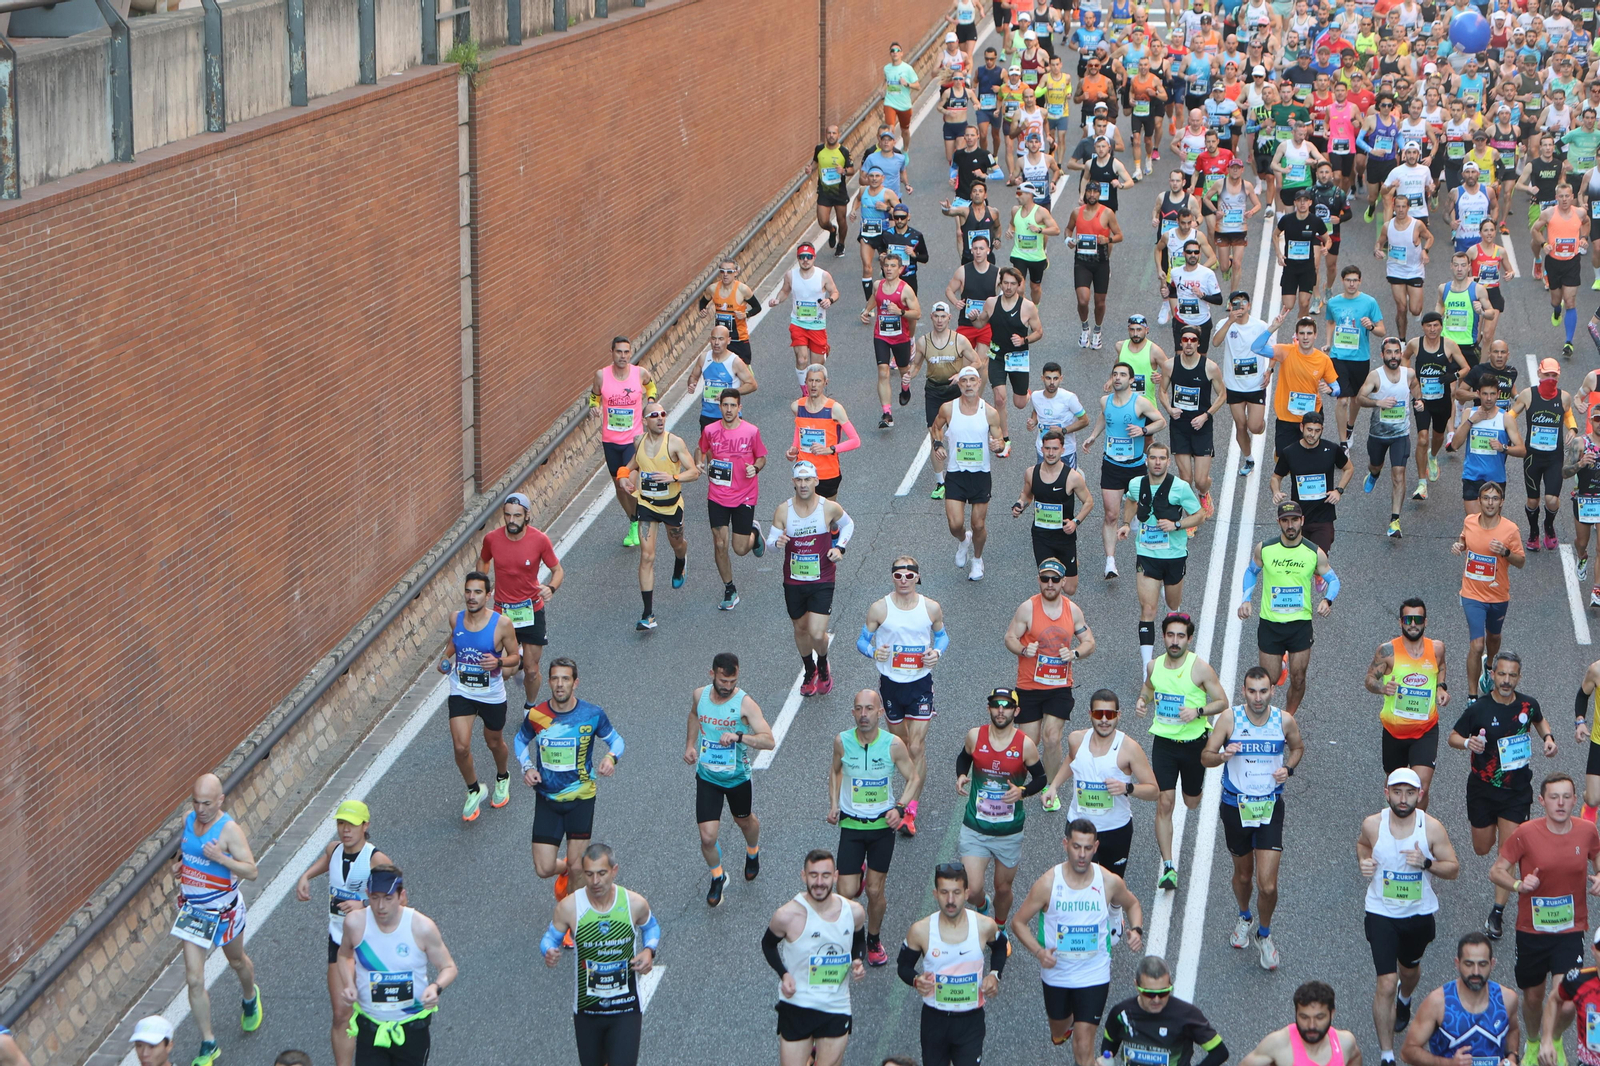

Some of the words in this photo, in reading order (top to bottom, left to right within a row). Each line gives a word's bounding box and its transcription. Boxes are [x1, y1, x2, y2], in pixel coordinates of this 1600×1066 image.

[715, 459, 729, 468] ZURICH
[1043, 504, 1059, 512] ZURICH
[1475, 555, 1493, 563] ZURICH
[1409, 689, 1430, 697] ZURICH
[1510, 735, 1528, 744] ZURICH
[864, 779, 885, 787] ZURICH
[1055, 900, 1102, 912] PORTUGAL
[1546, 897, 1568, 906] ZURICH
[193, 910, 215, 922] ZURICH
[825, 956, 847, 965] ZURICH
[600, 962, 622, 971] ZURICH
[384, 973, 409, 981] ZURICH
[950, 975, 973, 984] ZURICH
[384, 987, 400, 995] 2487
[949, 988, 964, 996] 2030
[1137, 1053, 1163, 1062] ZURICH
